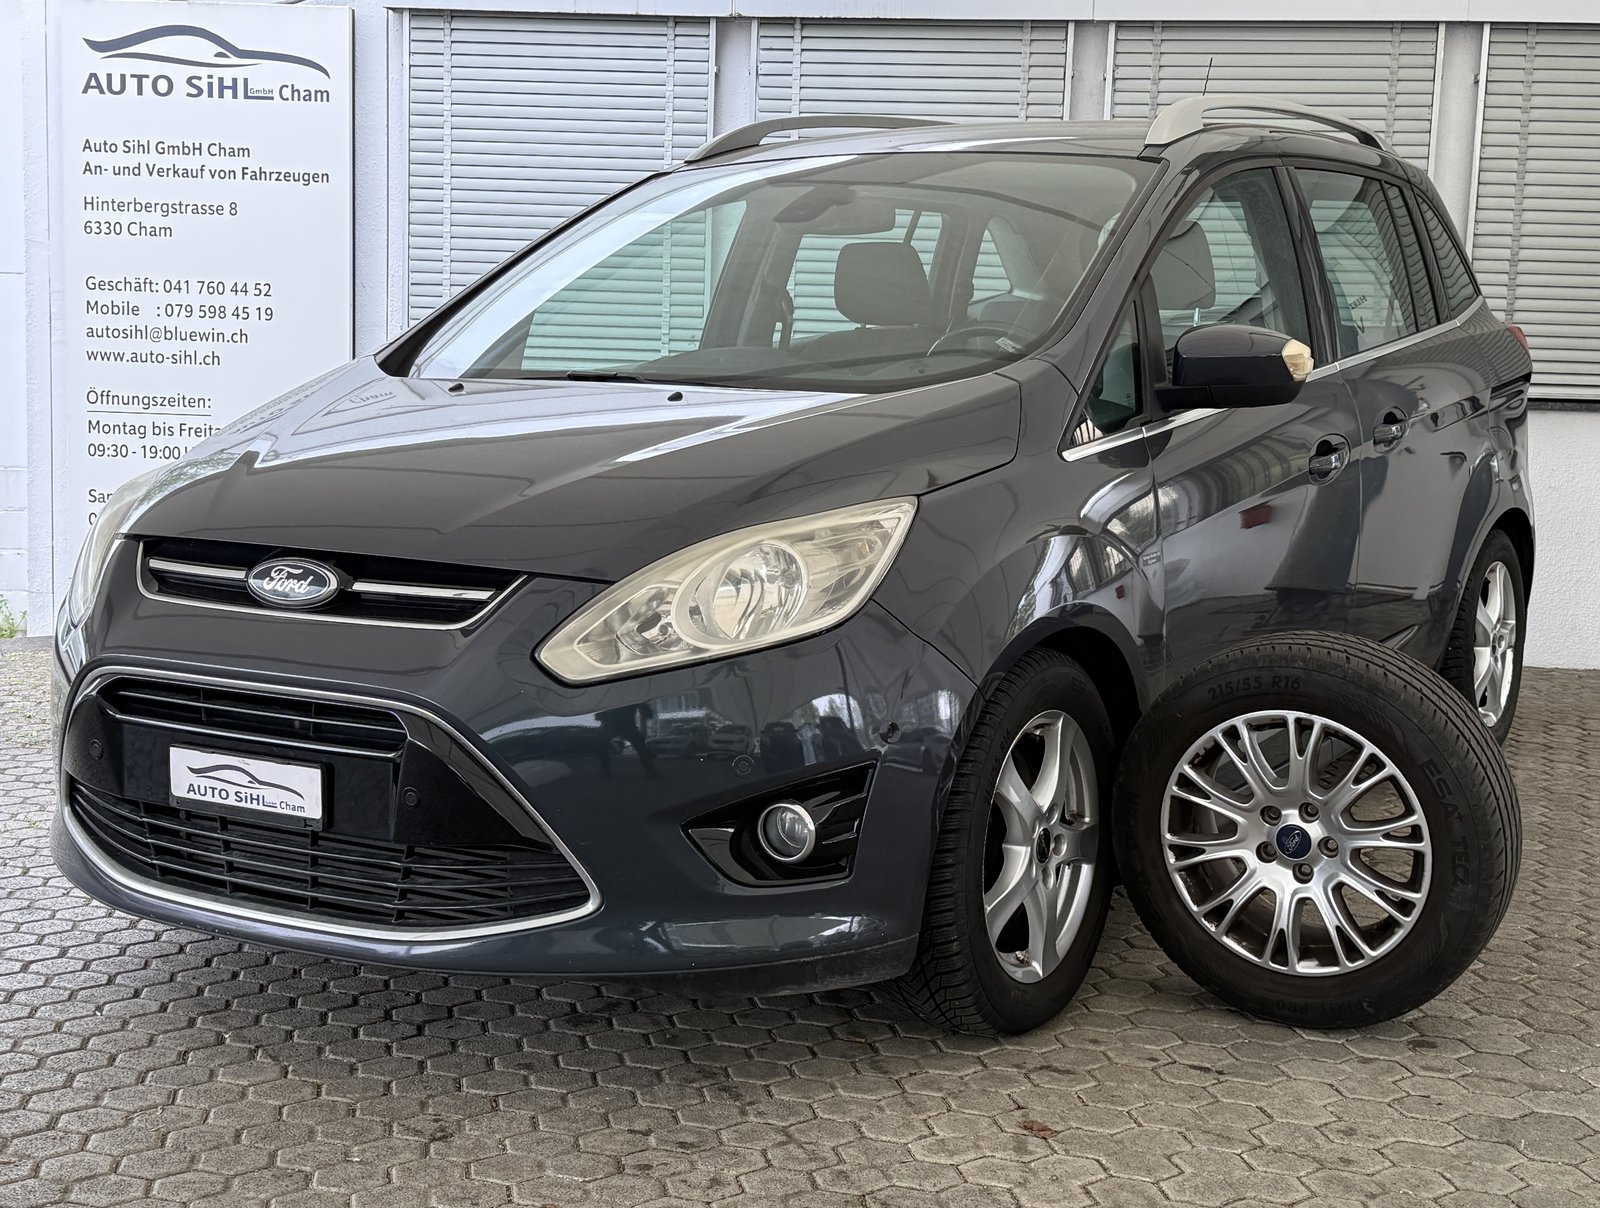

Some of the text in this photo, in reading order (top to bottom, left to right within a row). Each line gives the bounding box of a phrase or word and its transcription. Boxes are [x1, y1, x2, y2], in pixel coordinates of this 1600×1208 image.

[81, 72, 330, 103] AUTO SiHL GmbH Cham
[82, 138, 251, 158] Auto Sihl GmbH Cham
[82, 161, 330, 187] An- und Verkauf von Fahrzeugen
[83, 195, 238, 218] Hinterbergstrasse 8
[83, 220, 173, 238] 6330 Cham
[85, 275, 272, 297] Geschäft: 041 760 44 52
[86, 299, 140, 317] Mobile
[164, 303, 194, 318] 079
[198, 304, 227, 320] 598
[231, 305, 250, 321] 45
[255, 306, 274, 322] 19
[86, 324, 248, 344] autosihl@bluewin.ch
[86, 349, 221, 366] www.auto-sihl.ch
[86, 386, 211, 411] Öffnungszeiten:
[88, 419, 147, 440] Montag
[152, 420, 175, 437] bis
[87, 443, 129, 458] 09:30
[140, 444, 181, 460] 19:00
[263, 566, 312, 594] Ford
[1207, 675, 1301, 700] 215/55 R16
[186, 782, 230, 801] AUTO
[234, 790, 277, 809] SiHL
[279, 800, 306, 814] Cham
